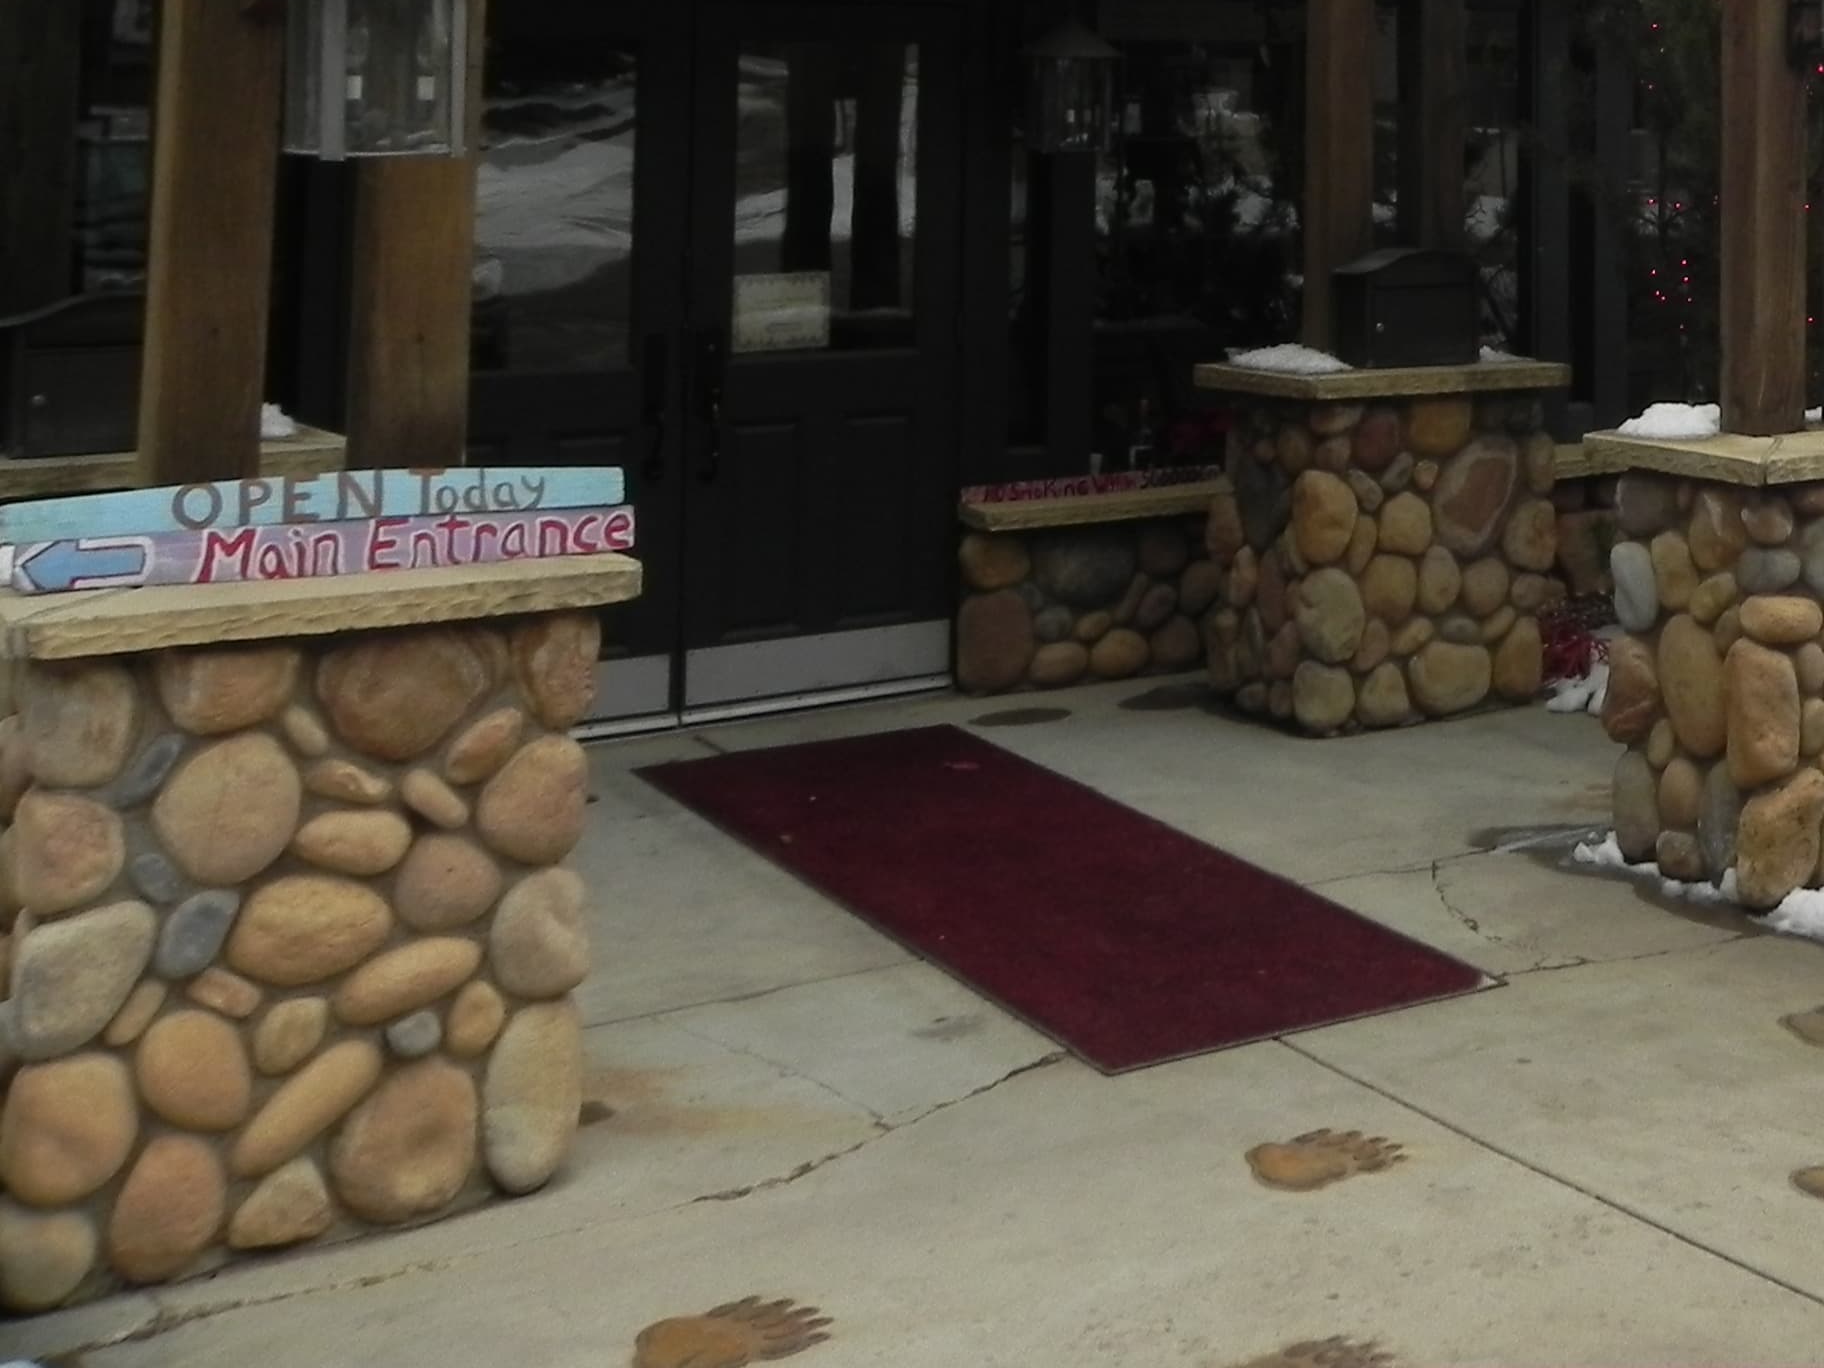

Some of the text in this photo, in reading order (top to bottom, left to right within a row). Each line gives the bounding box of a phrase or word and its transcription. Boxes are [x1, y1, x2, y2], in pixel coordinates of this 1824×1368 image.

[172, 467, 546, 530] OPEN Today
[195, 509, 634, 584] Main Entrance
